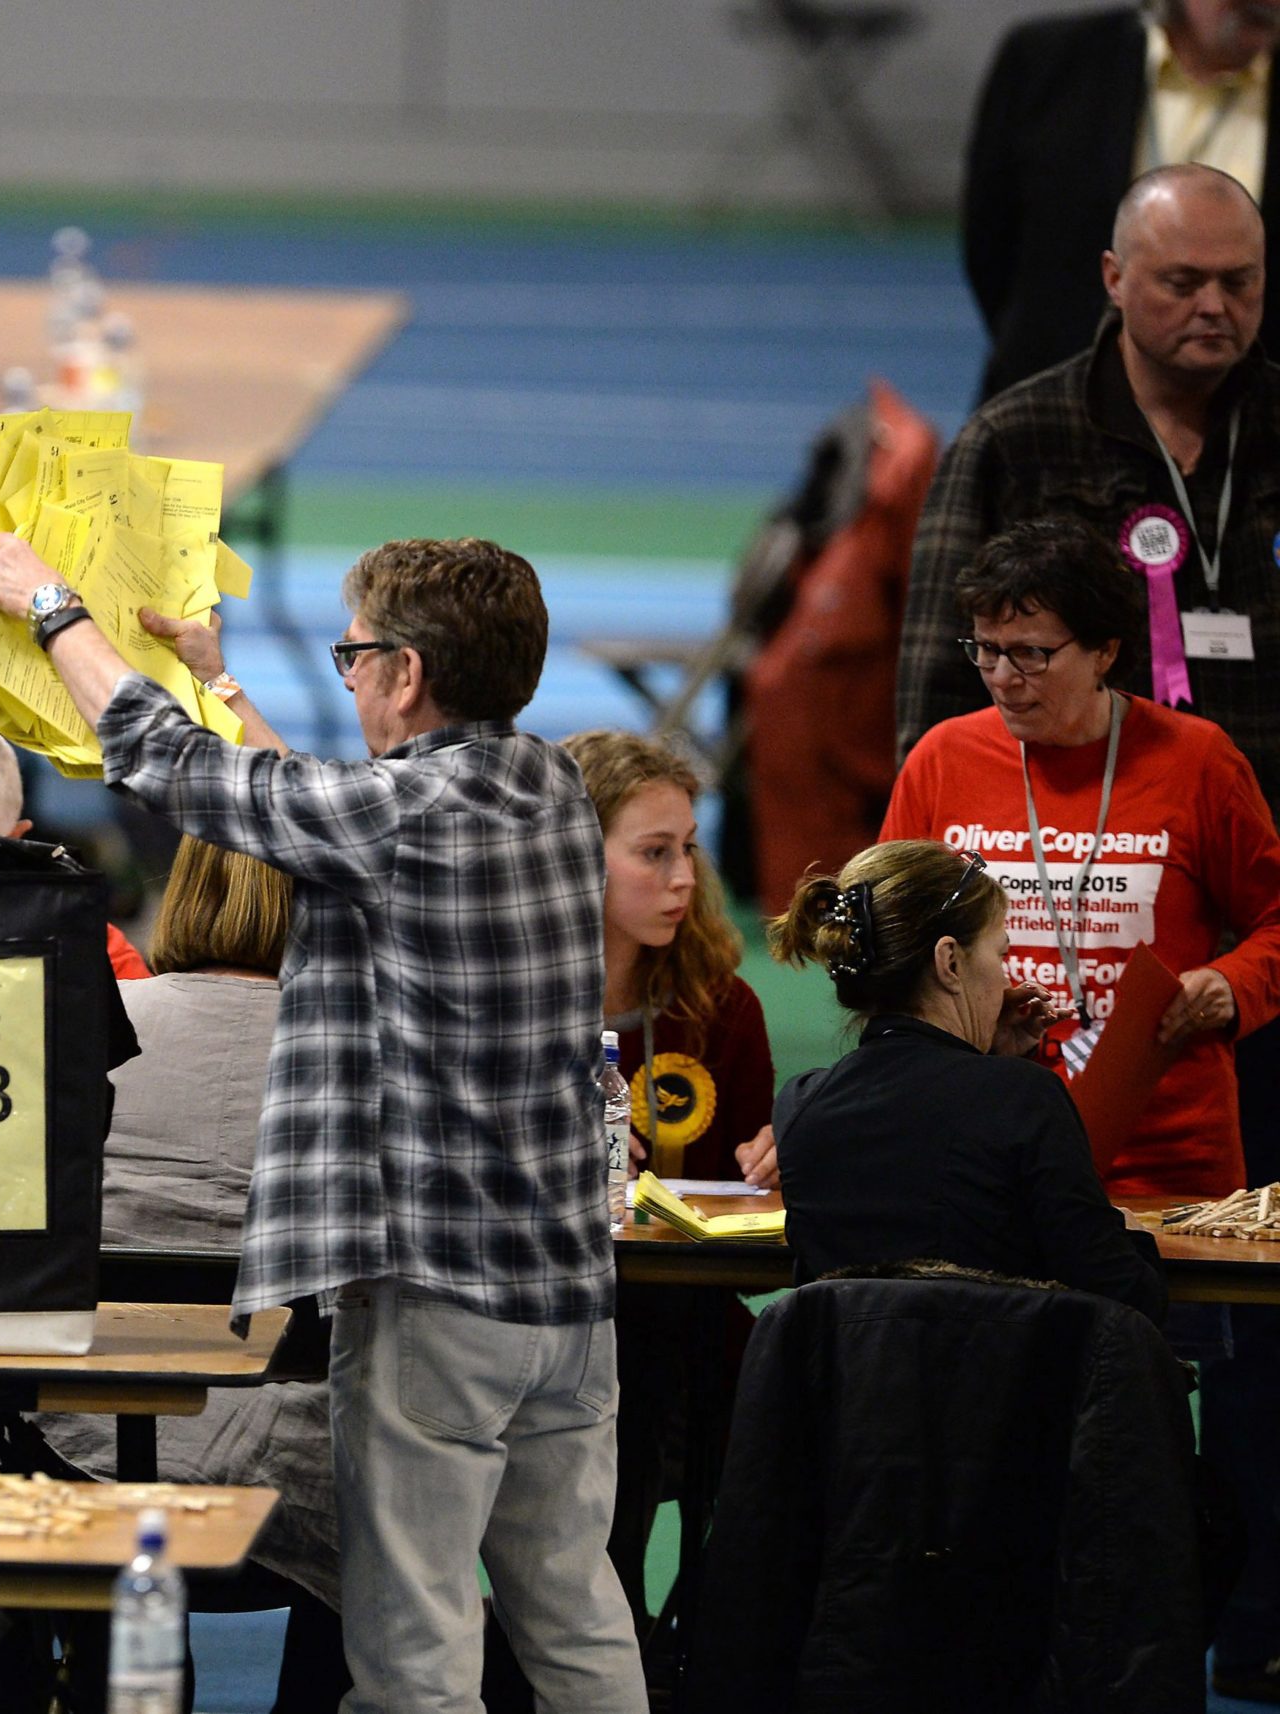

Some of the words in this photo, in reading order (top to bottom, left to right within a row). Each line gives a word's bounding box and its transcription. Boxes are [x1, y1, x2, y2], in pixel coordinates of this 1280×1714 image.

[943, 823, 1032, 854] Oliver
[1039, 826, 1169, 860] Coppard
[1079, 874, 1128, 893] 2015
[1077, 897, 1139, 914] Hallam
[1060, 918, 1120, 934] Hallam
